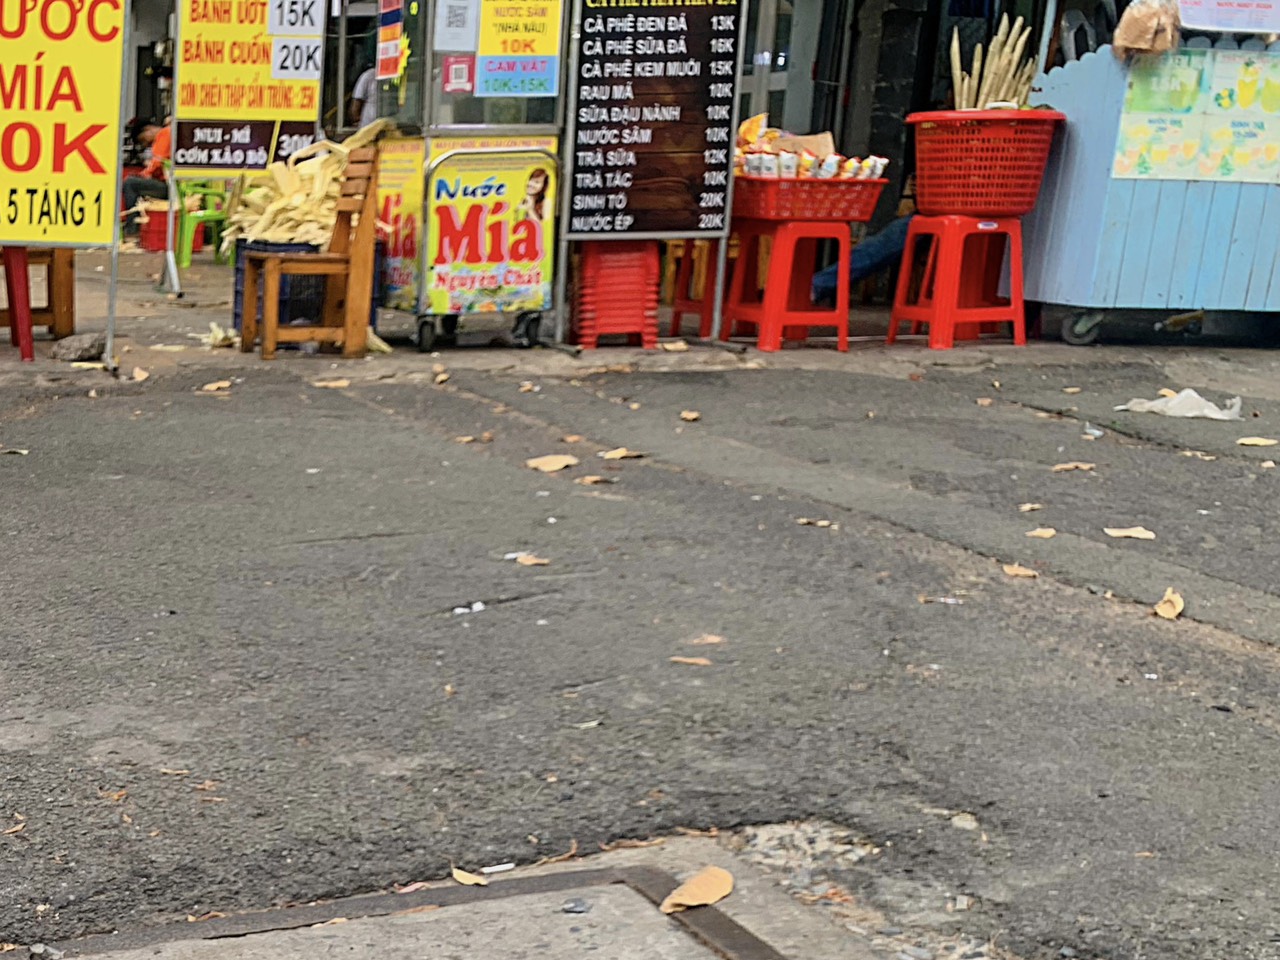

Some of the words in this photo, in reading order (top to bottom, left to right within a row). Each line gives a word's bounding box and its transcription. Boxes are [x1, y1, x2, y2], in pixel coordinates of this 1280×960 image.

[276, 1, 315, 26] 15K
[584, 15, 605, 33] CÀ
[607, 14, 635, 32] PHÊ
[636, 17, 666, 32] ĐEN
[667, 13, 688, 31] ĐÁ
[710, 15, 736, 31] 13K
[182, 33, 225, 64] BÁNH
[229, 32, 272, 64] CUỐN
[279, 44, 320, 71] 20K
[500, 39, 536, 53] 10K
[583, 37, 604, 55] CÀ
[605, 36, 634, 55] PHÊ
[636, 36, 666, 54] SỮA
[667, 35, 687, 54] ĐÁ
[486, 60, 517, 73] CAM
[581, 59, 602, 78] CÀ
[604, 59, 633, 77] PHÊ
[634, 62, 665, 77] KEM
[580, 85, 610, 100] RAU
[709, 83, 733, 98] 10K
[578, 104, 609, 123] SỮA
[642, 103, 681, 121] NÀNH
[706, 105, 730, 120] 10K
[577, 126, 620, 144] NƯỚC
[705, 127, 729, 142] 10K
[575, 148, 604, 166] TRÀ
[606, 148, 637, 166] SỮA
[435, 176, 506, 200] Nước
[574, 170, 603, 188] TRÀ
[7, 188, 19, 224] 5
[26, 183, 86, 235] TẶNG
[93, 190, 103, 227] 1
[573, 194, 606, 210] SINH
[571, 213, 613, 231] NƯỚC
[434, 202, 544, 265] Mía
[435, 270, 499, 291] Nguyên
[504, 264, 542, 286] Chất
